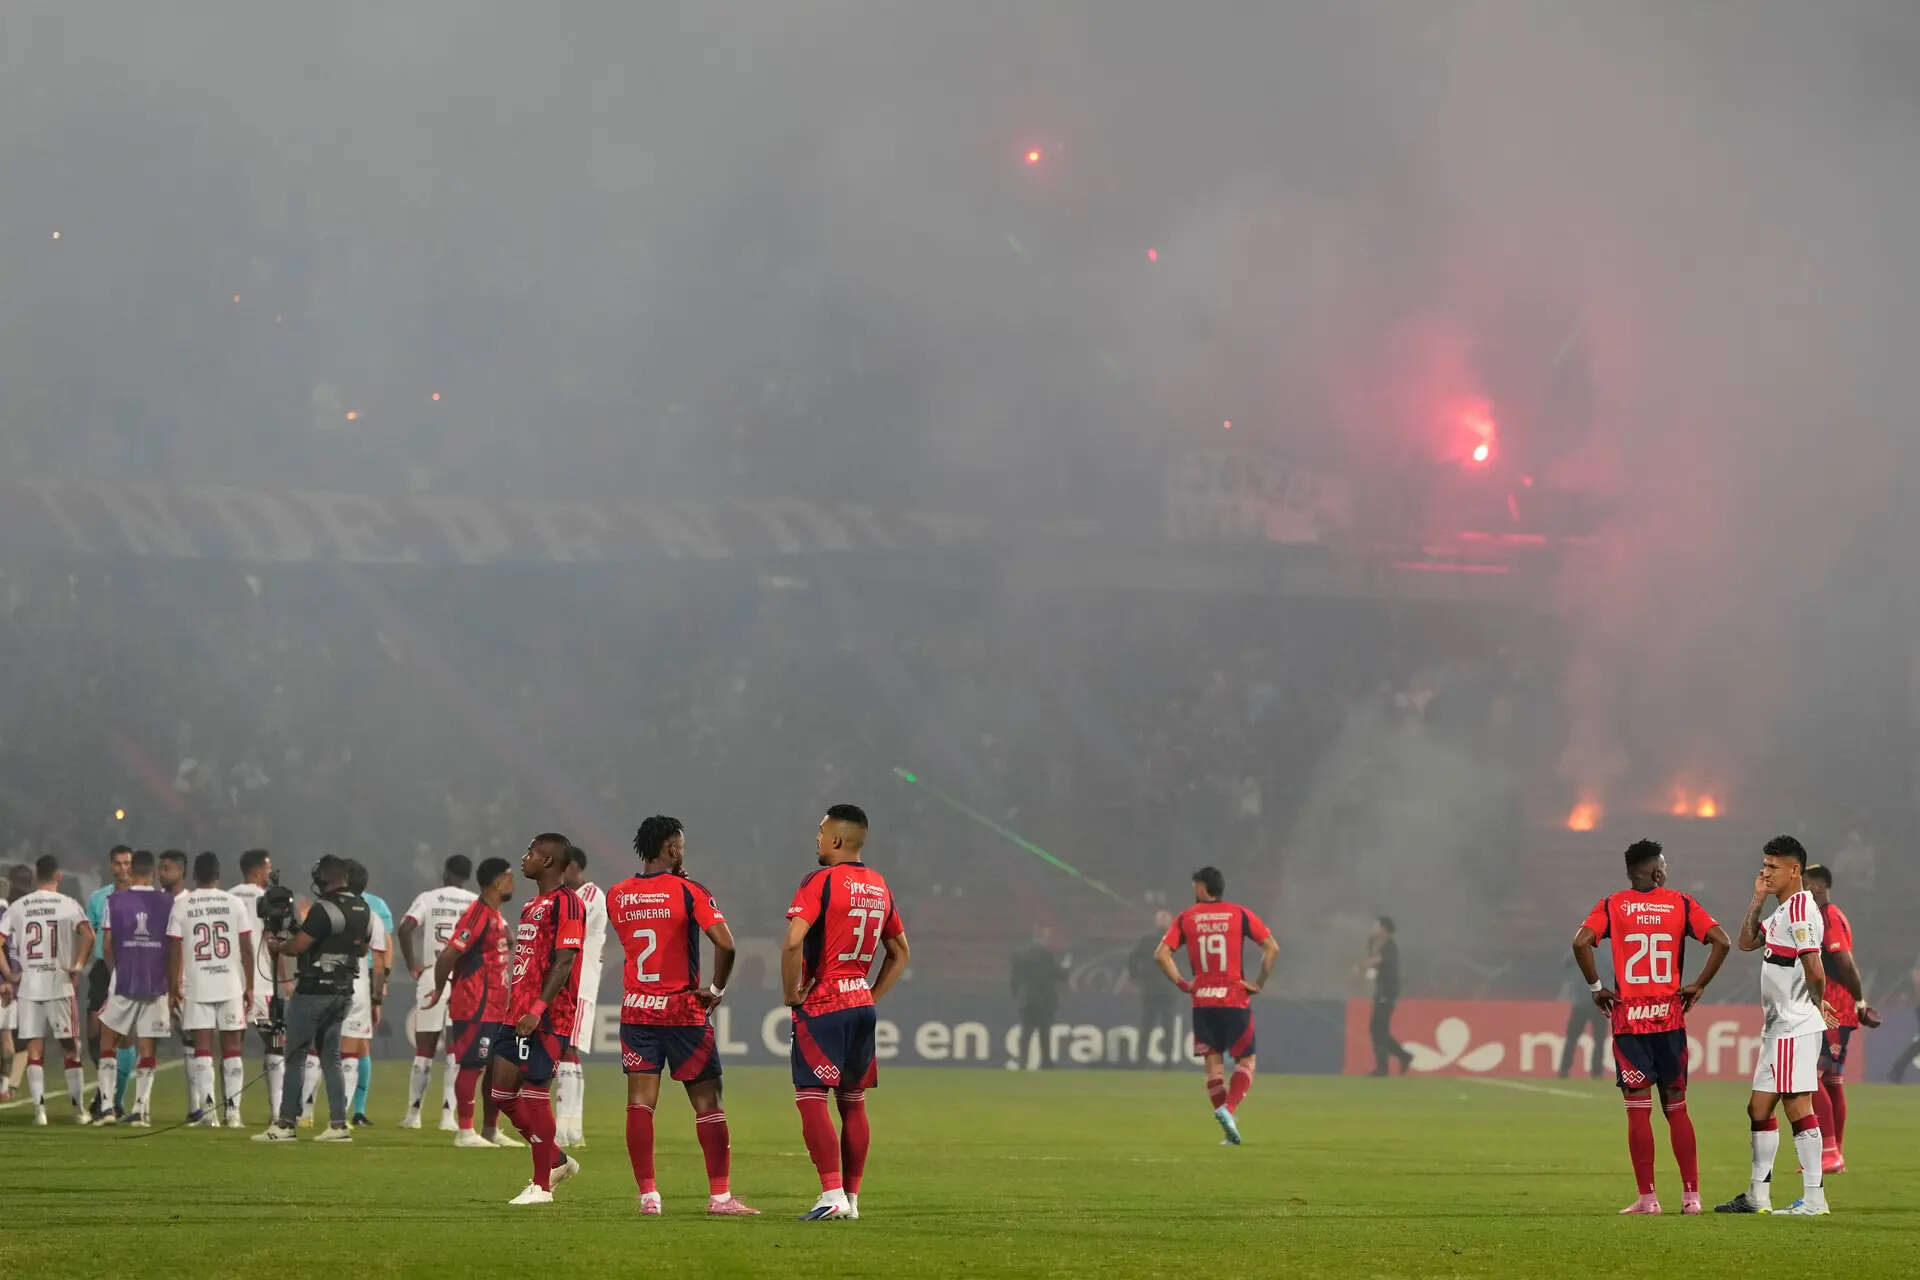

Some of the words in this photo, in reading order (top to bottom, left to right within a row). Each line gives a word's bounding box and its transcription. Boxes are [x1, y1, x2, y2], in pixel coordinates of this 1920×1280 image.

[187, 909, 204, 918] ALEX
[206, 907, 230, 916] SANDRO
[620, 893, 639, 908] JFK
[1627, 902, 1646, 916] JFK
[617, 912, 626, 923] L.
[625, 908, 671, 921] CHAVERRA
[1636, 914, 1661, 925] MENA
[26, 920, 58, 960] 21
[193, 921, 231, 961] 26
[838, 908, 884, 962] 33
[633, 928, 660, 982] 2
[1198, 934, 1227, 973] 19
[1624, 933, 1673, 984] 26
[623, 992, 670, 1010] MAPEI
[1627, 1003, 1670, 1021] MAPEI
[915, 1020, 990, 1061] en
